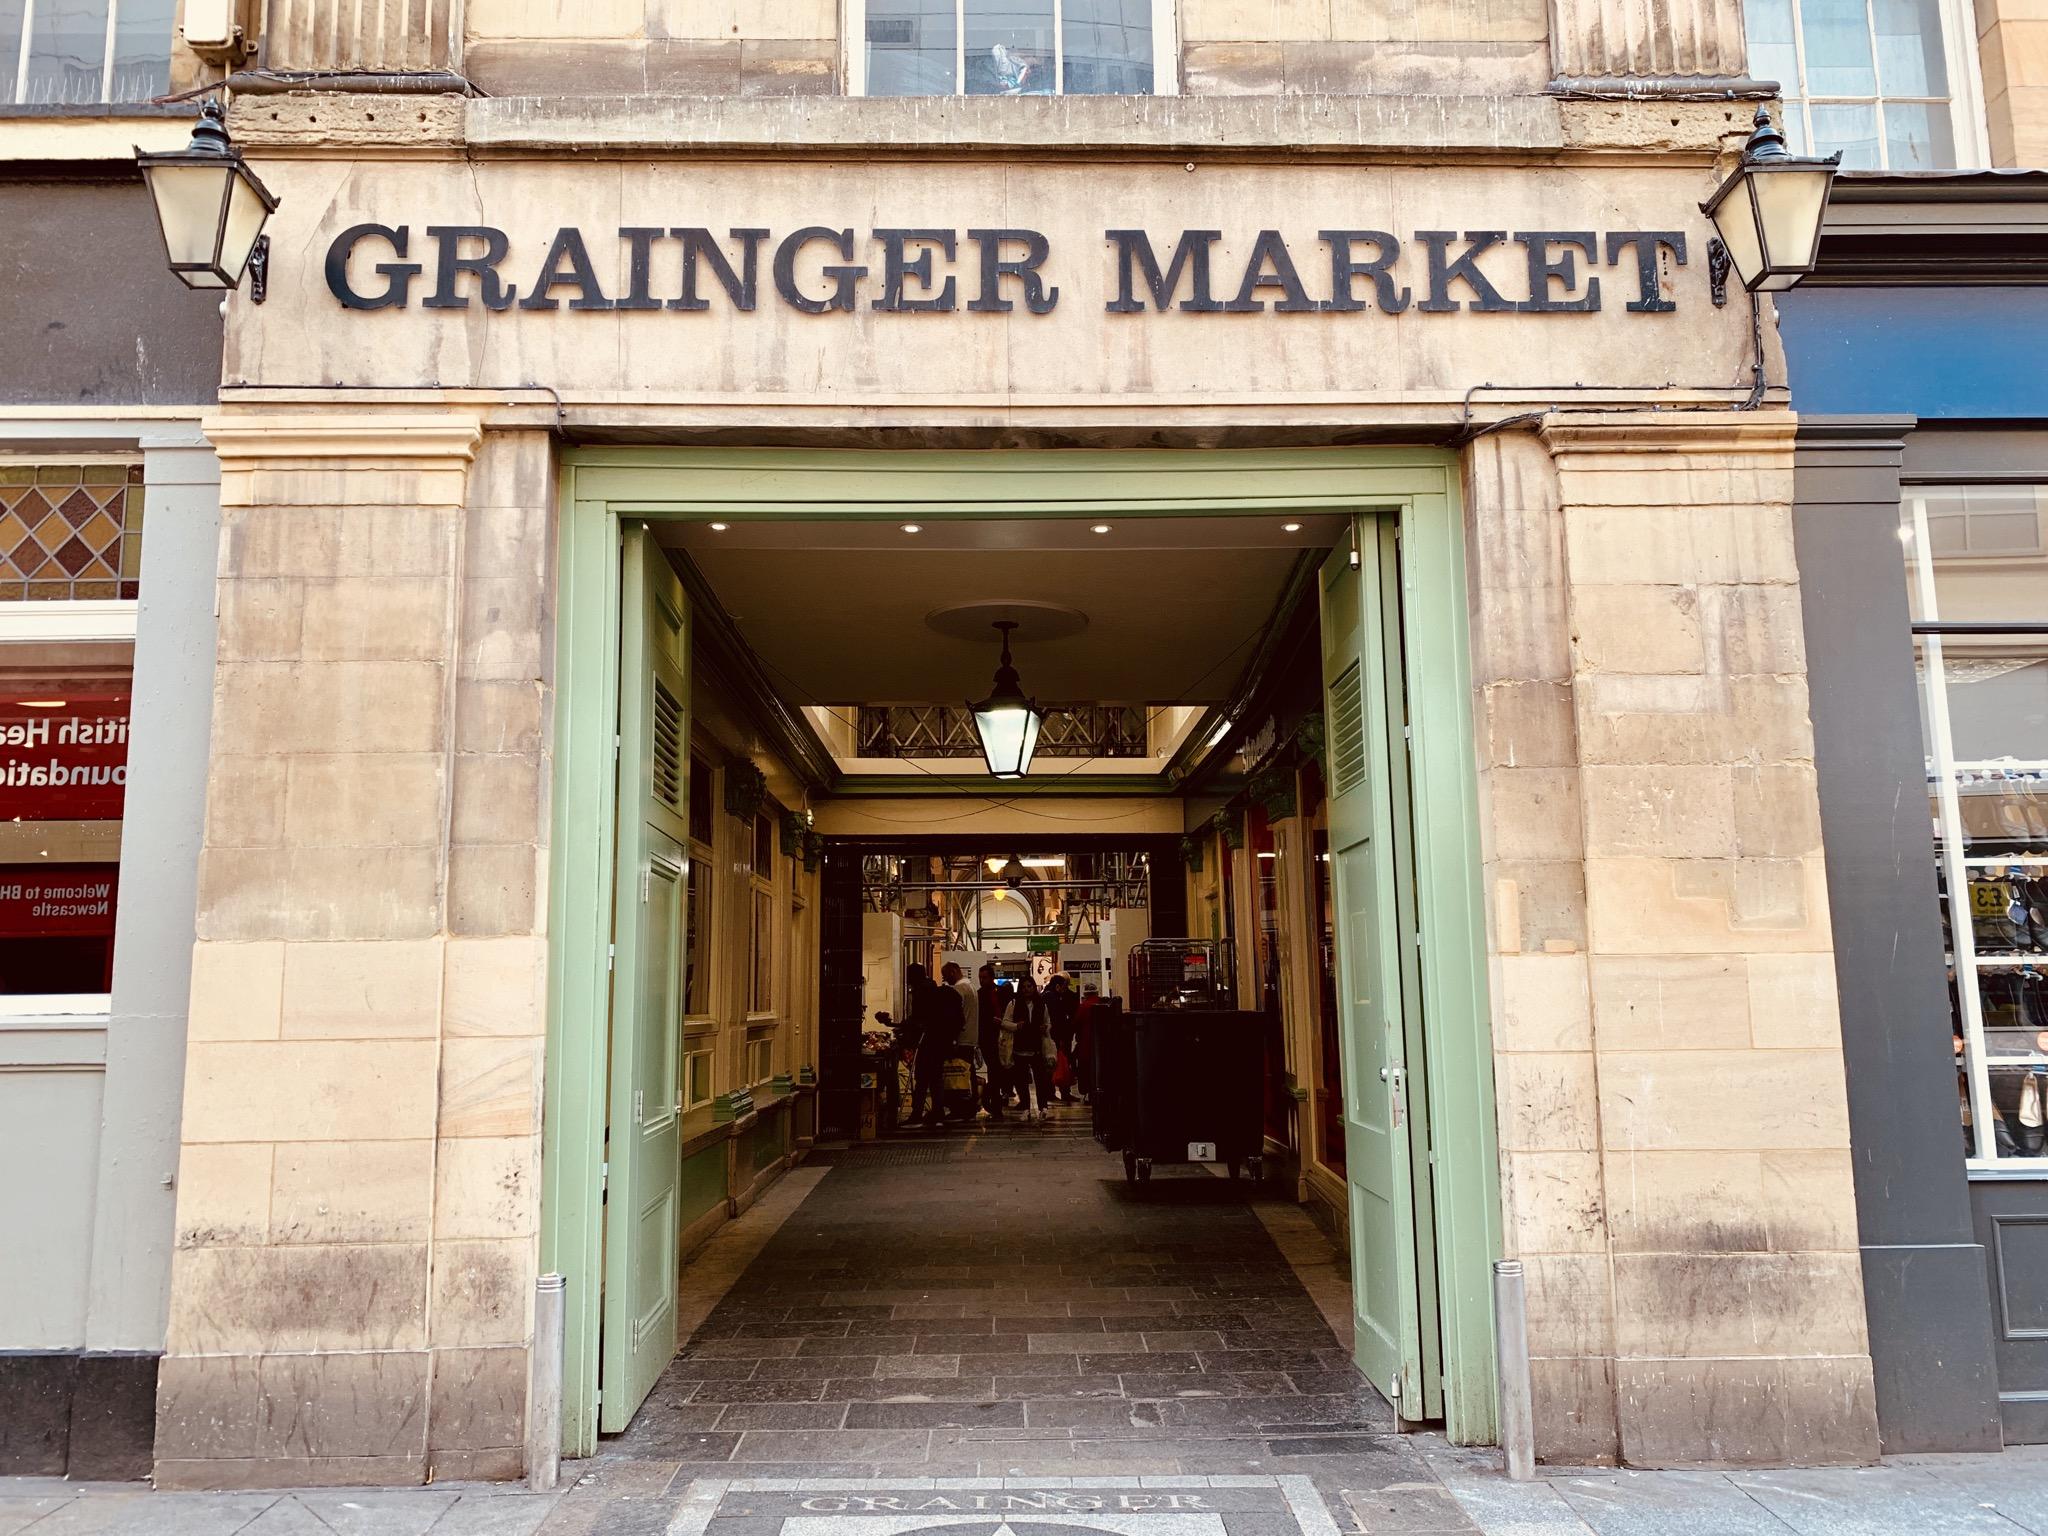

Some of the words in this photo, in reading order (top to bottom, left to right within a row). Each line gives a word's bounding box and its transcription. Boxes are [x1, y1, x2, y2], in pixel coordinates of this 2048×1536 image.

[324, 223, 1059, 313] GRAINGER
[1104, 229, 1688, 313] MARKET
[800, 1494, 1216, 1511] GRAINGER
